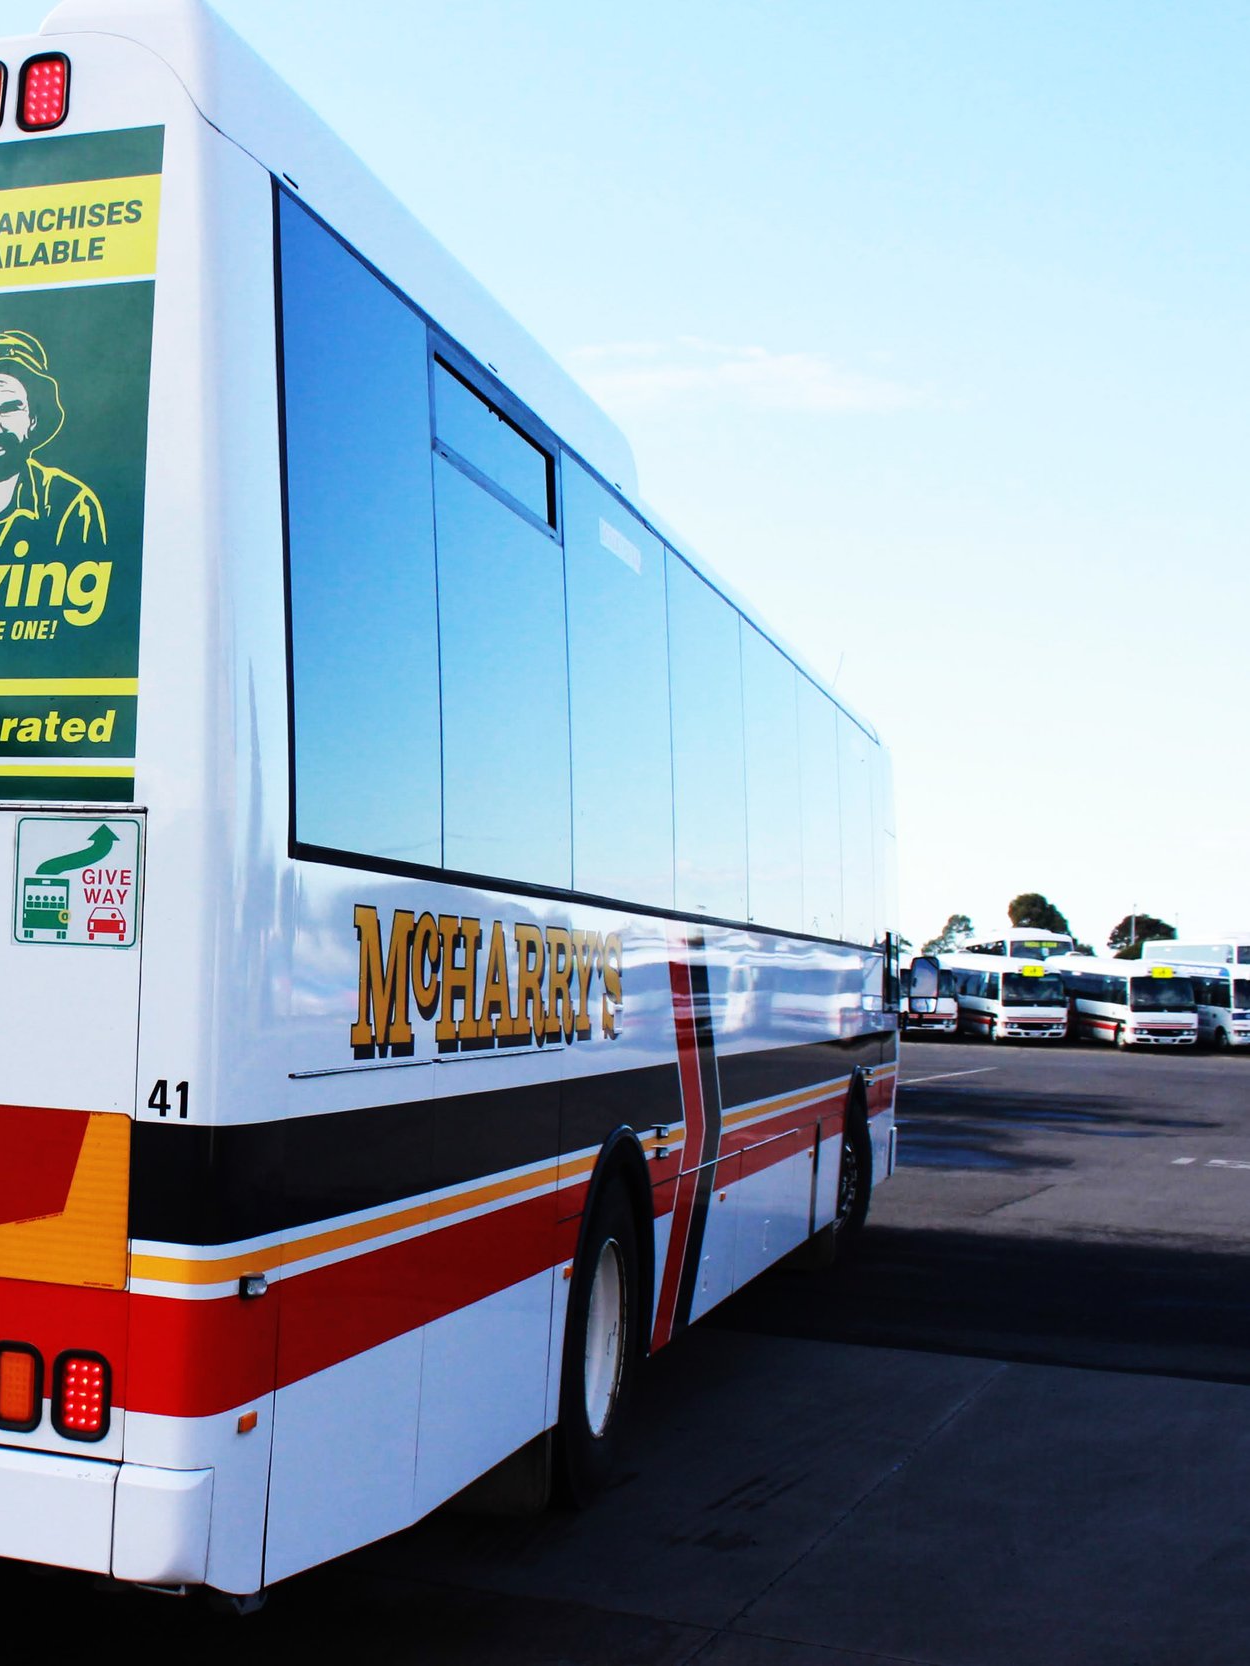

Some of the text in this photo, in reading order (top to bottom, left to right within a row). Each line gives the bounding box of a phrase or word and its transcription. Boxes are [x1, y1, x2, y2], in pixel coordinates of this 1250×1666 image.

[11, 620, 58, 640] ONE!
[82, 868, 132, 886] GIVE
[83, 888, 128, 905] WAY
[148, 1079, 189, 1119] 41
